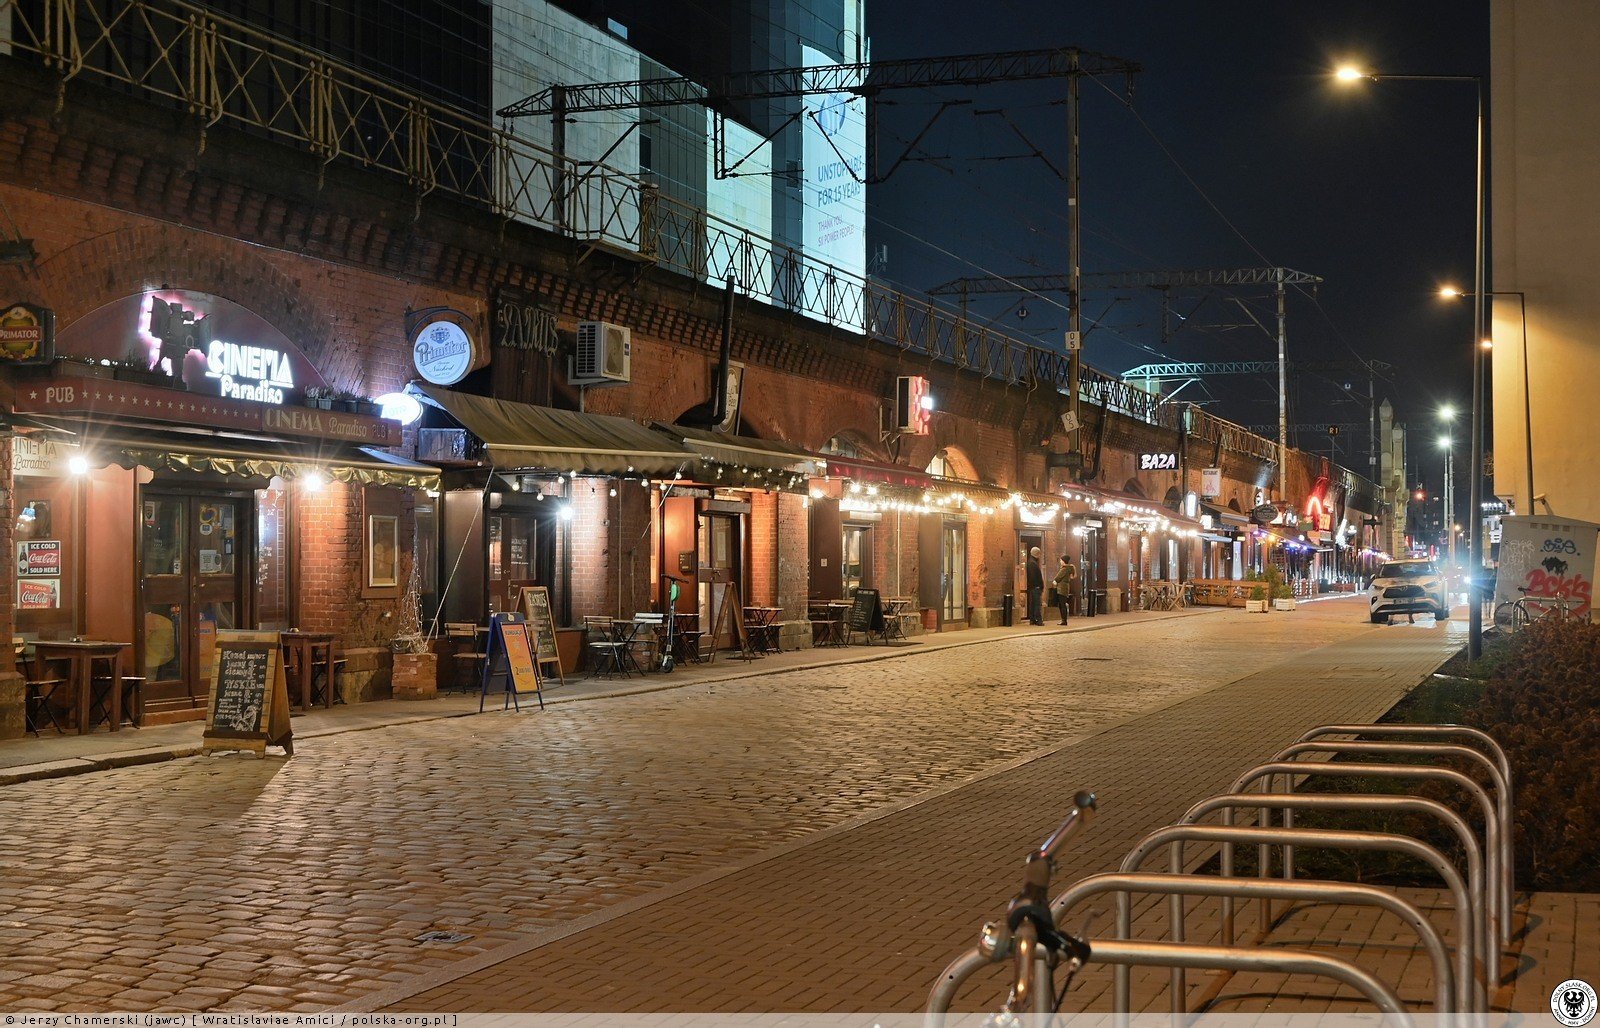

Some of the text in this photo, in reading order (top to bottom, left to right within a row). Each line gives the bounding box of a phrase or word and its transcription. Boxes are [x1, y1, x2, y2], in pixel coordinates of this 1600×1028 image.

[818, 181, 860, 208] FOR 15 YEARS
[205, 340, 295, 389] CINEMA
[45, 386, 75, 404] PUB
[221, 374, 283, 405] Paradiso
[266, 408, 386, 438] CINEMA Paradiso PUB
[13, 454, 51, 470] Paradiso
[1141, 453, 1176, 469] BAZA
[225, 680, 256, 689] TYSKIE
